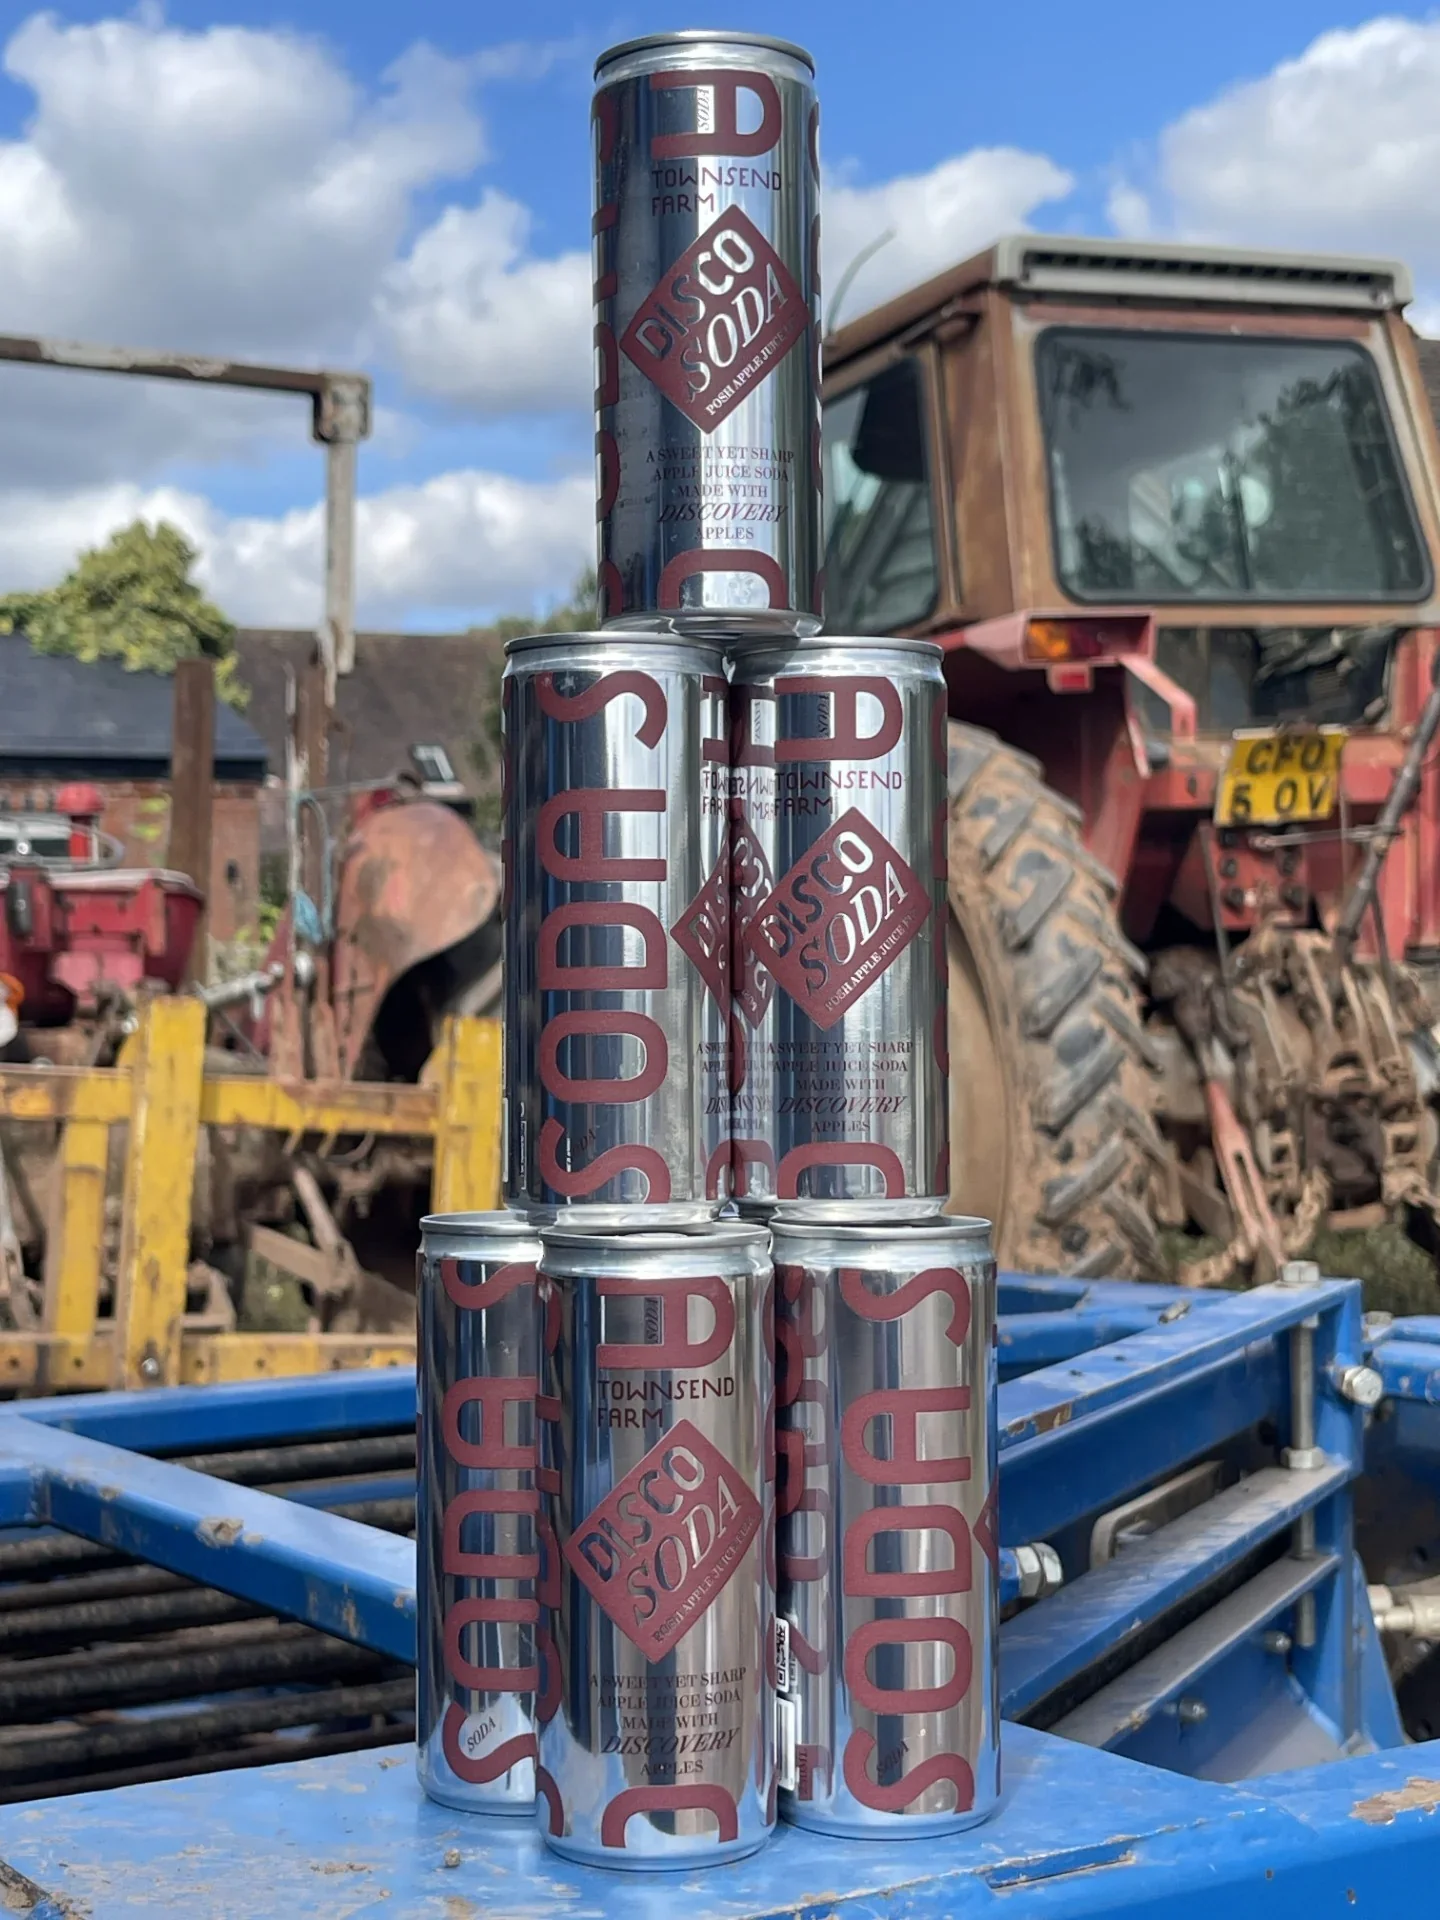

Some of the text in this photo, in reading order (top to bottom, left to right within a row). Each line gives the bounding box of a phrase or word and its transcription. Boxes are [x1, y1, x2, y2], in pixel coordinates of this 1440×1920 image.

[651, 166, 782, 191] TOWNSEND
[652, 193, 714, 216] FARM
[635, 229, 754, 360] DISCO
[680, 263, 788, 403] SODA
[705, 383, 735, 415] POSH
[733, 357, 763, 390] APPLE
[646, 450, 655, 463] A
[717, 446, 749, 460] YET
[751, 447, 794, 464] SHARP
[654, 465, 789, 482] APPLE JUICE SODA
[678, 484, 768, 498] MADE WITH
[657, 503, 788, 523] DISCOVERY
[774, 771, 902, 790] TOWNSEND
[774, 797, 835, 816] FARM
[760, 831, 873, 958] DISCO
[536, 671, 671, 1205] SODAS
[800, 861, 909, 996] SODA
[825, 926, 905, 1012] POSH APPLE JUICE
[777, 1041, 830, 1054] SWEET
[834, 1041, 864, 1053] YET
[868, 1041, 913, 1054] SHARP
[774, 1060, 908, 1073] APPLE JUICE SODA
[796, 1078, 885, 1091] MADE WITH
[778, 1096, 907, 1114] DISCOVERY
[812, 1121, 870, 1133] APPLES
[598, 1377, 734, 1400] TOWNSEND
[598, 1408, 663, 1428] FARM
[578, 1446, 705, 1582] DISCO
[627, 1475, 742, 1627] SODA
[838, 1268, 975, 1814] SODAS
[683, 1576, 713, 1612] APPLE
[590, 1667, 747, 1690] A SWEET YET SHARP
[597, 1690, 741, 1710] APPLE JUICE SODA
[623, 1713, 718, 1729] MADE WITH
[467, 1716, 497, 1752] SODA
[602, 1728, 740, 1755] DISCOVERY
[640, 1760, 704, 1776] APPLES
